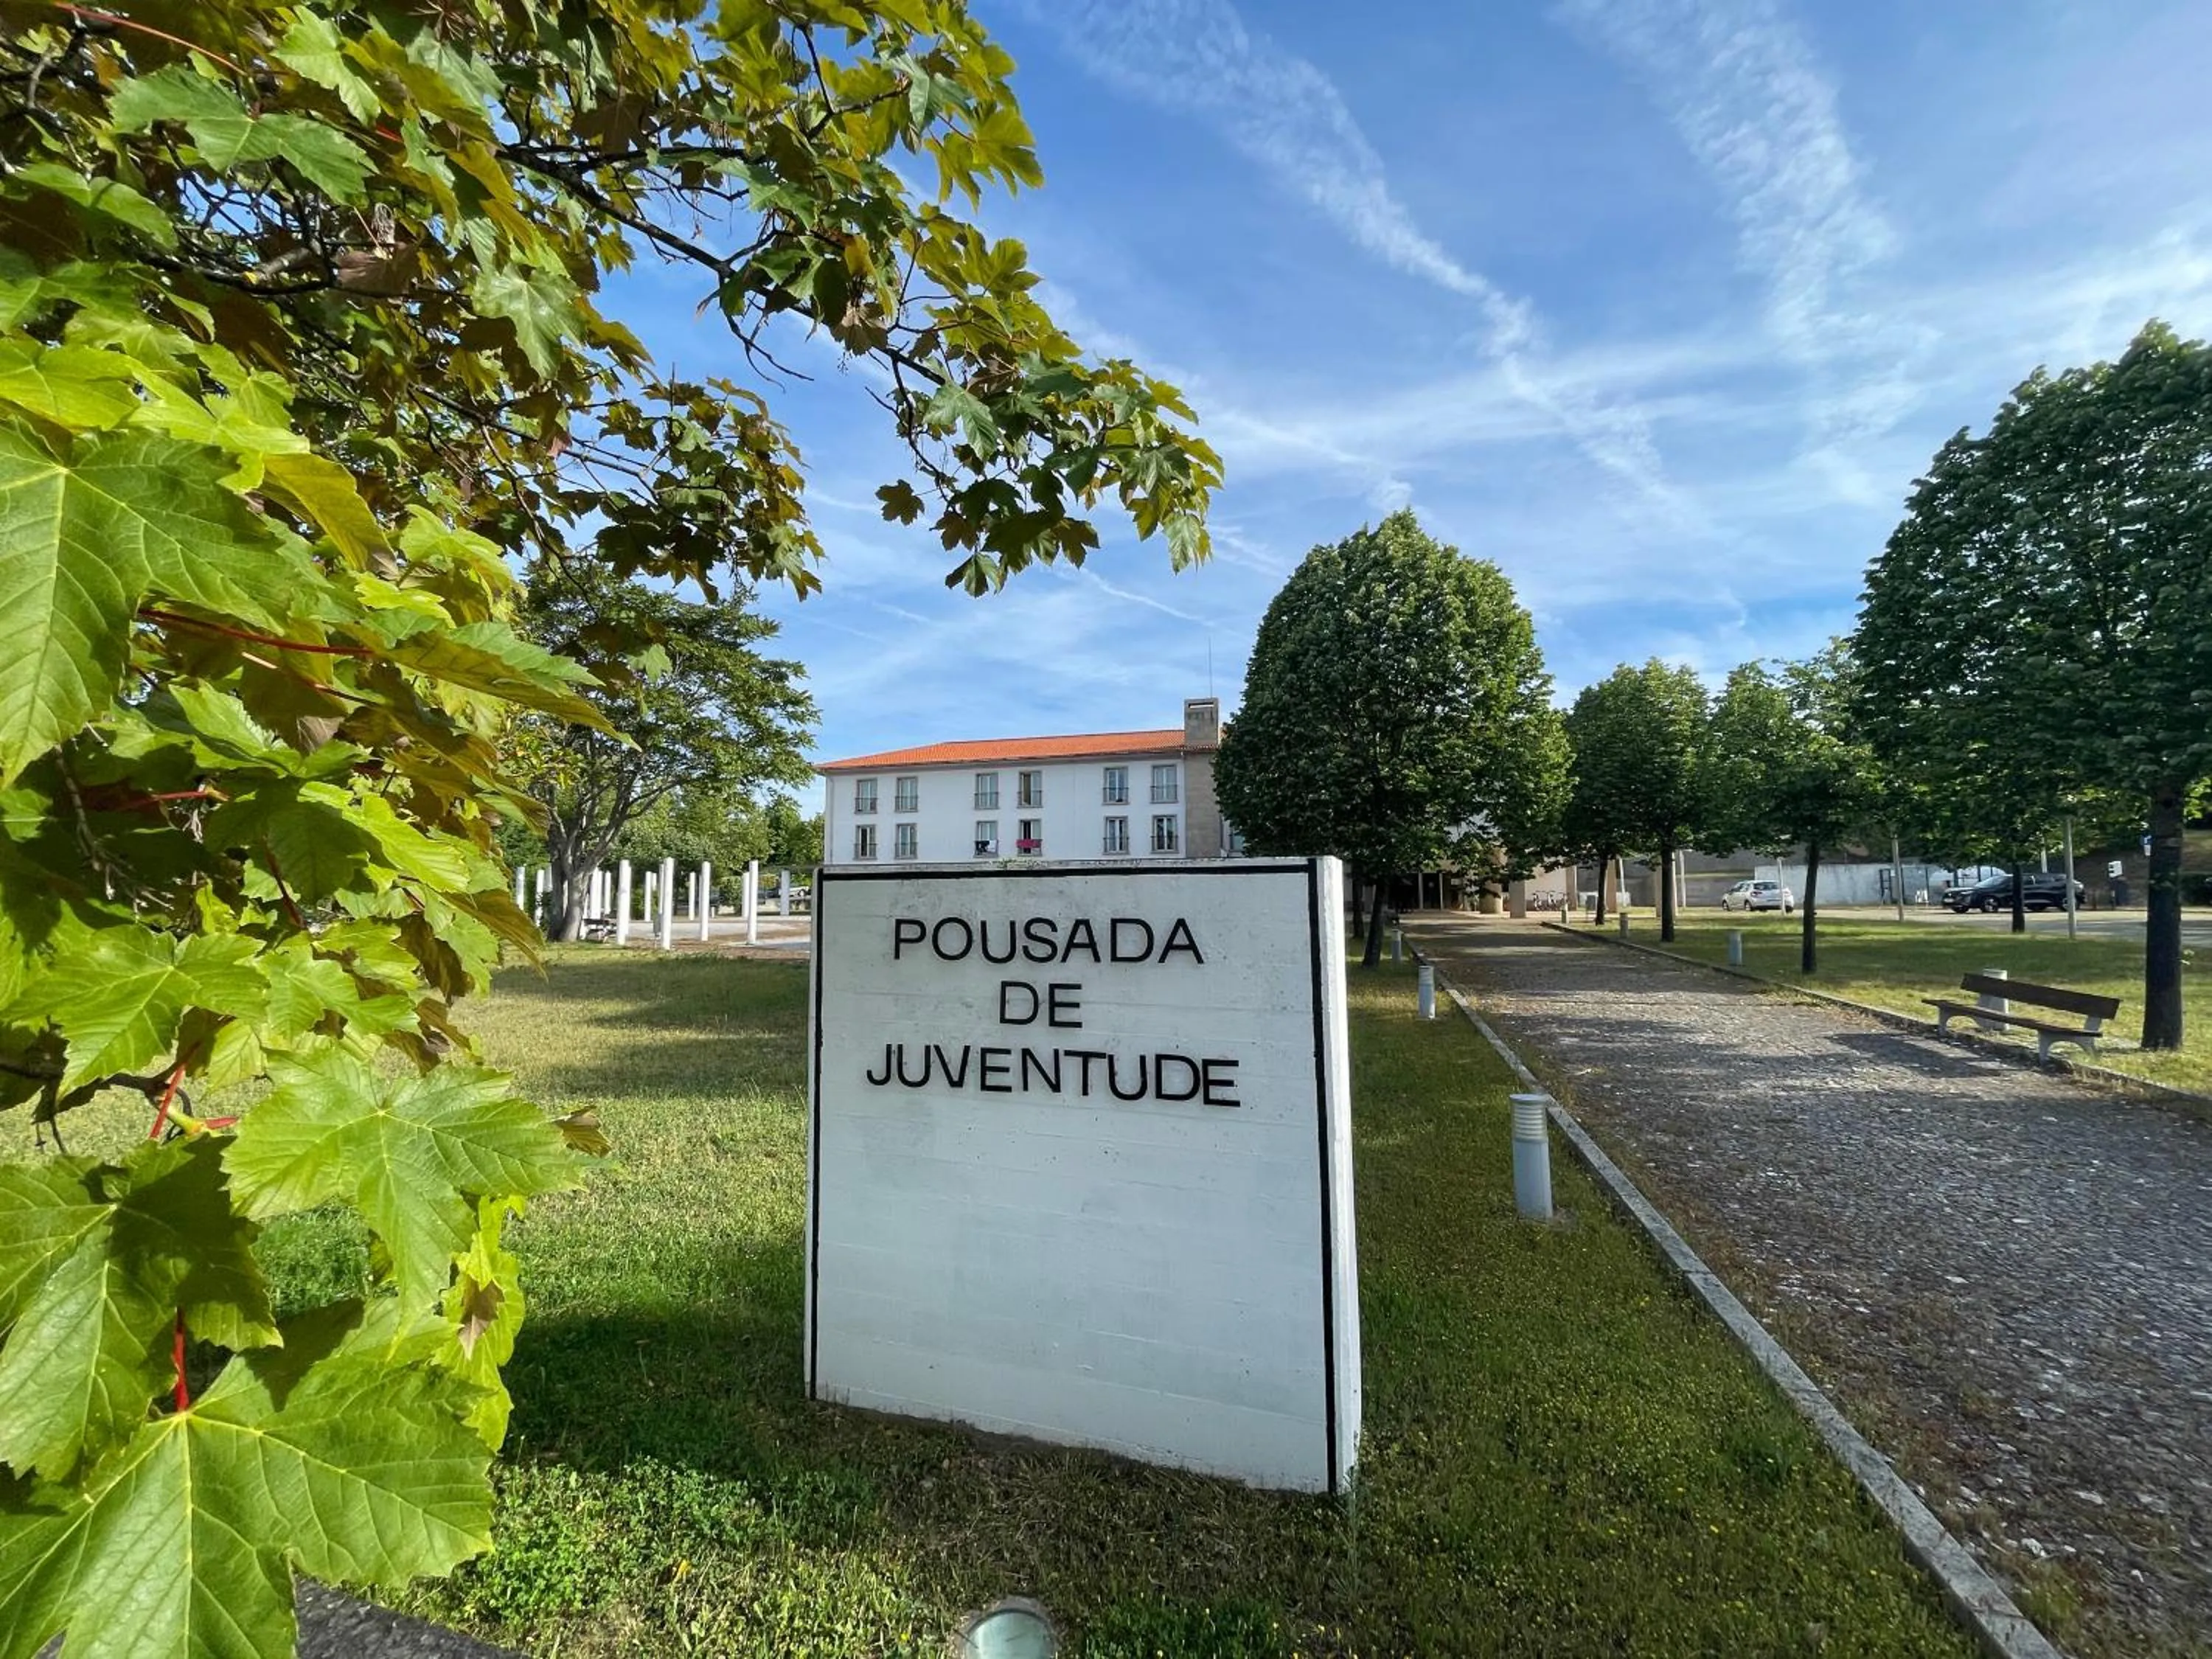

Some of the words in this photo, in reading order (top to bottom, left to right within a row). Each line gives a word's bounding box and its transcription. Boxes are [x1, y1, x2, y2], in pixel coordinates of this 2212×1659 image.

[894, 917, 1204, 965] POUSADA
[999, 980, 1083, 1029] DE
[866, 1043, 1242, 1108] JUVENTUDE
